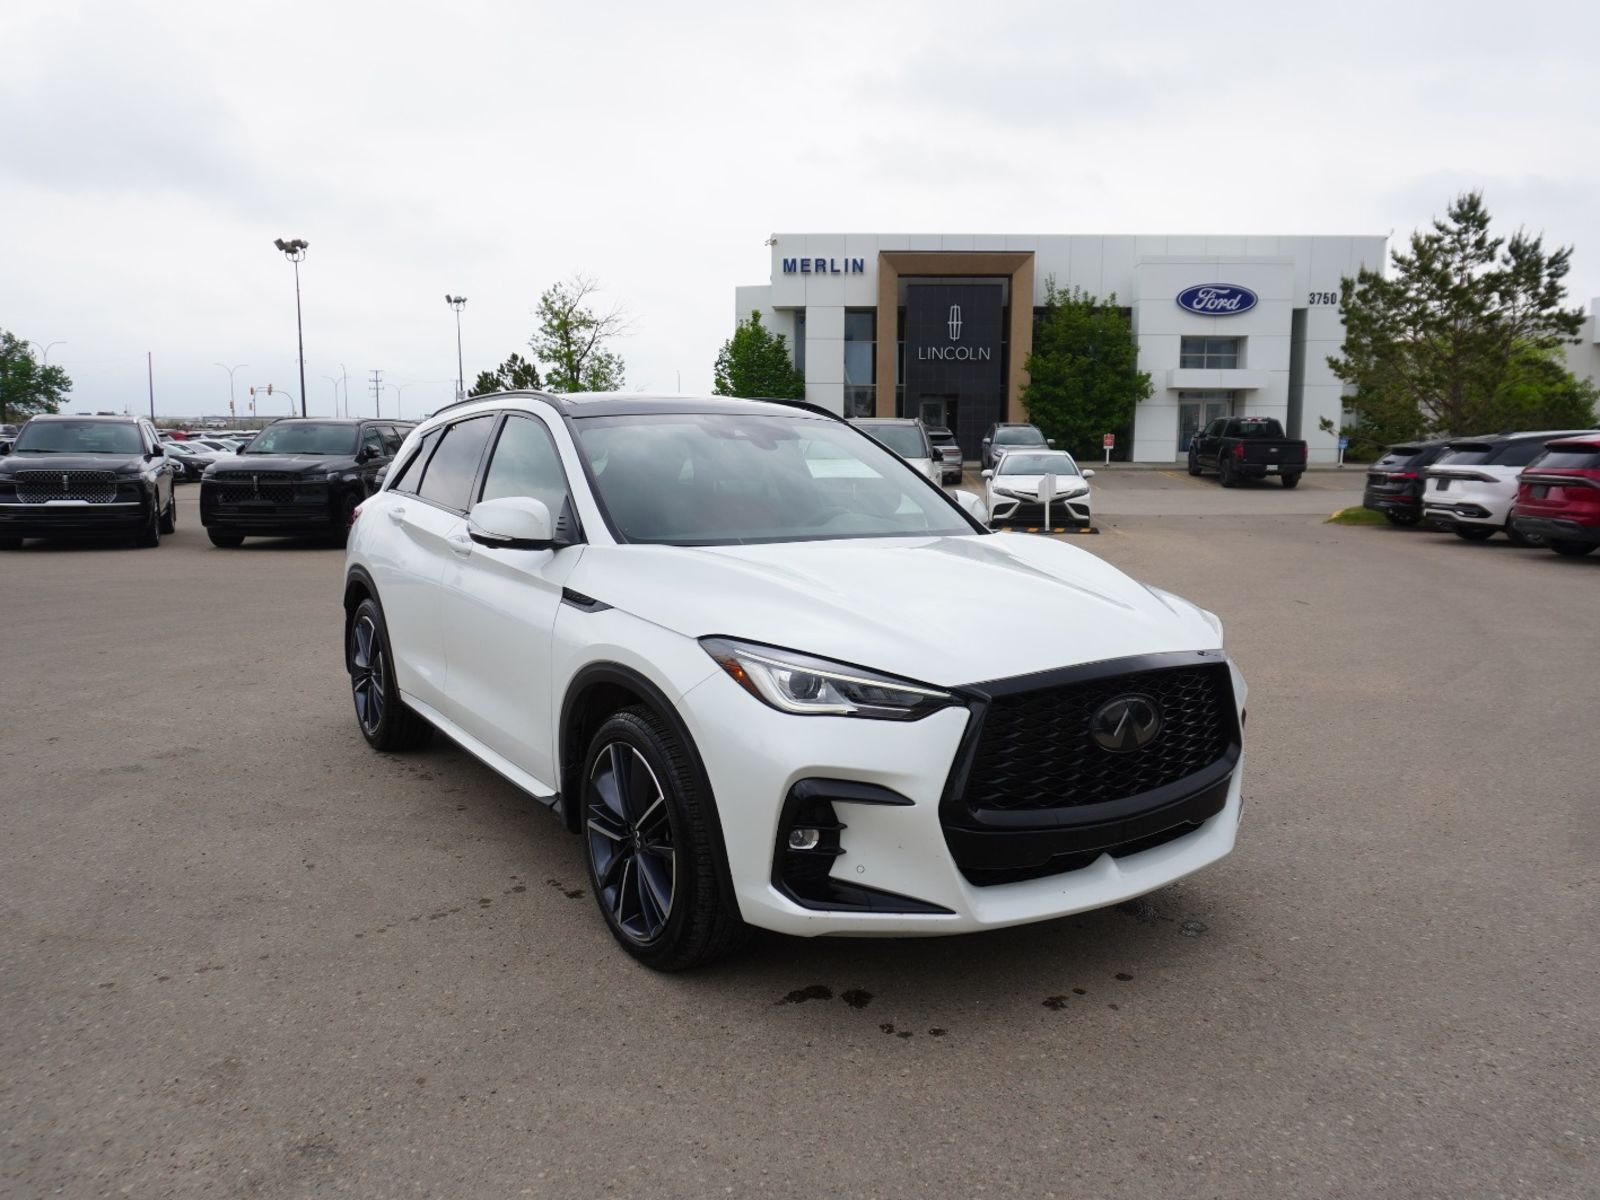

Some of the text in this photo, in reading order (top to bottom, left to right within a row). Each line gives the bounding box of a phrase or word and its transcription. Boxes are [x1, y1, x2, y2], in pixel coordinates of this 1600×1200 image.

[783, 258, 864, 273] MERLIN
[1192, 287, 1242, 310] Ford
[1309, 292, 1337, 305] 3750
[918, 345, 990, 360] LINCOLN
